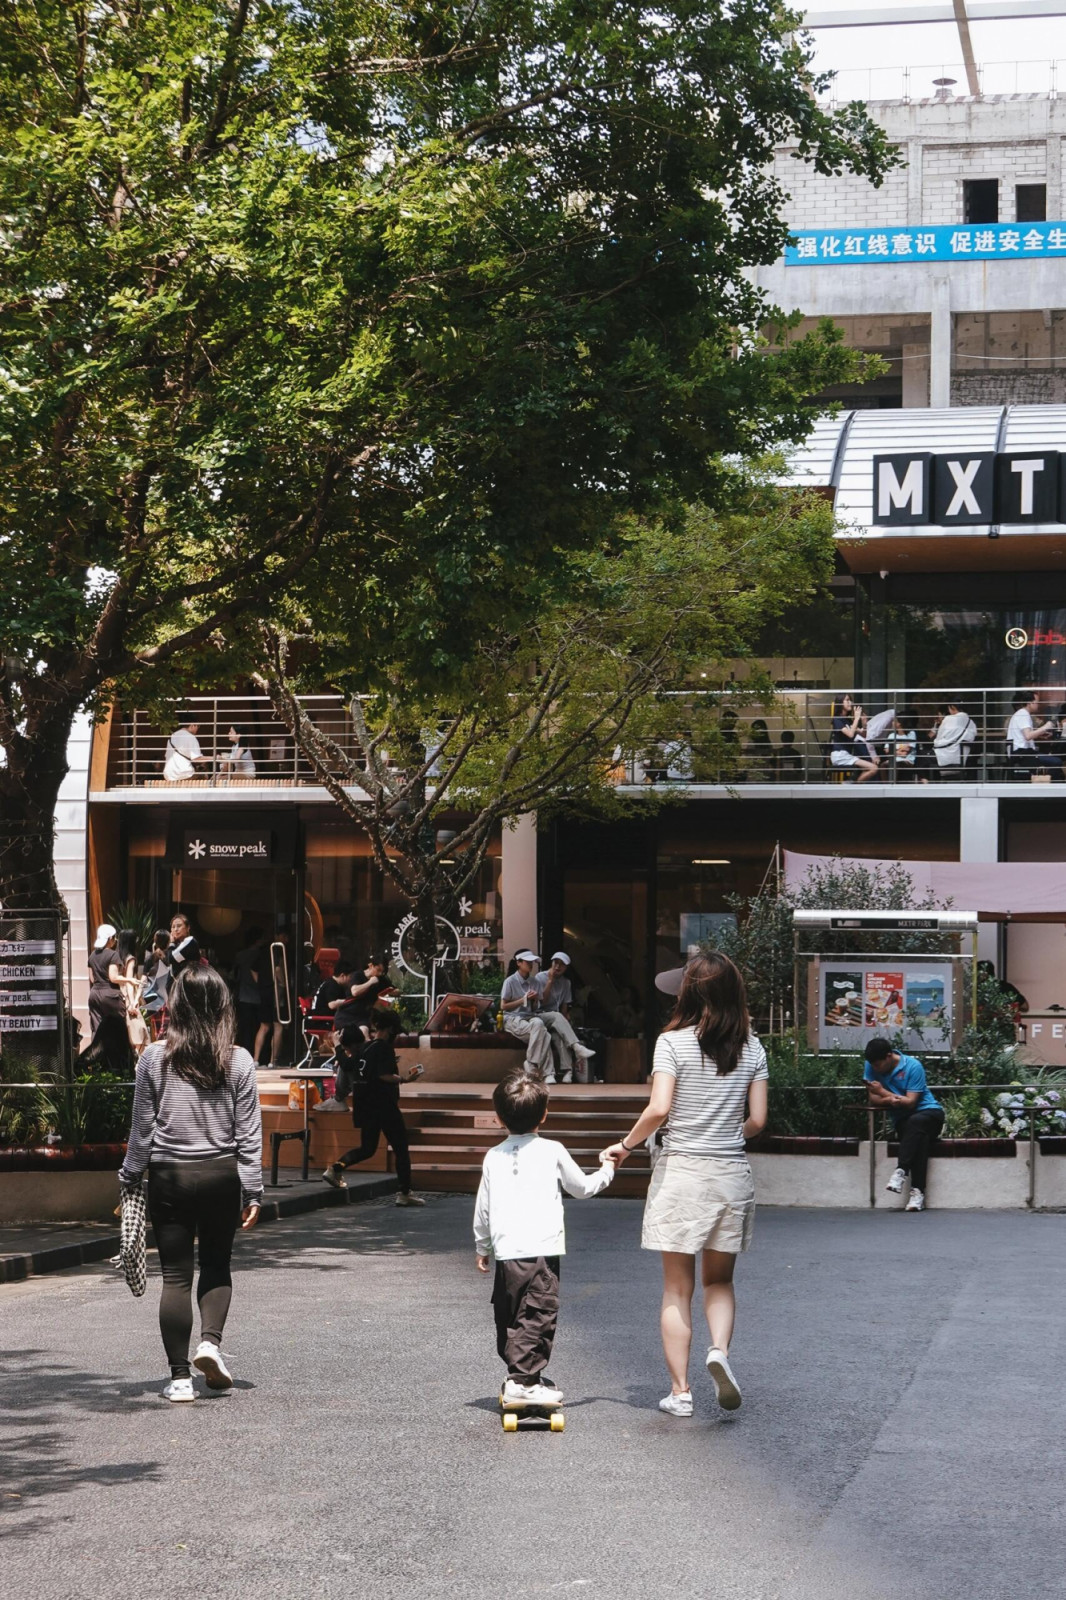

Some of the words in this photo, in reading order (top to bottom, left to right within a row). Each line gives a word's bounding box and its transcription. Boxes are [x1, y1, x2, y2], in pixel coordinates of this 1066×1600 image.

[797, 233, 937, 259] 强化红线意识
[949, 228, 1066, 253] 促进安全生
[878, 459, 1045, 516] MXT
[209, 844, 238, 853] snow
[239, 840, 267, 857] peak
[394, 912, 418, 935] PARK
[464, 922, 491, 937] peak
[2, 966, 36, 977] CHICKEN
[12, 992, 33, 1004] peak
[9, 1018, 41, 1029] BEAUTY
